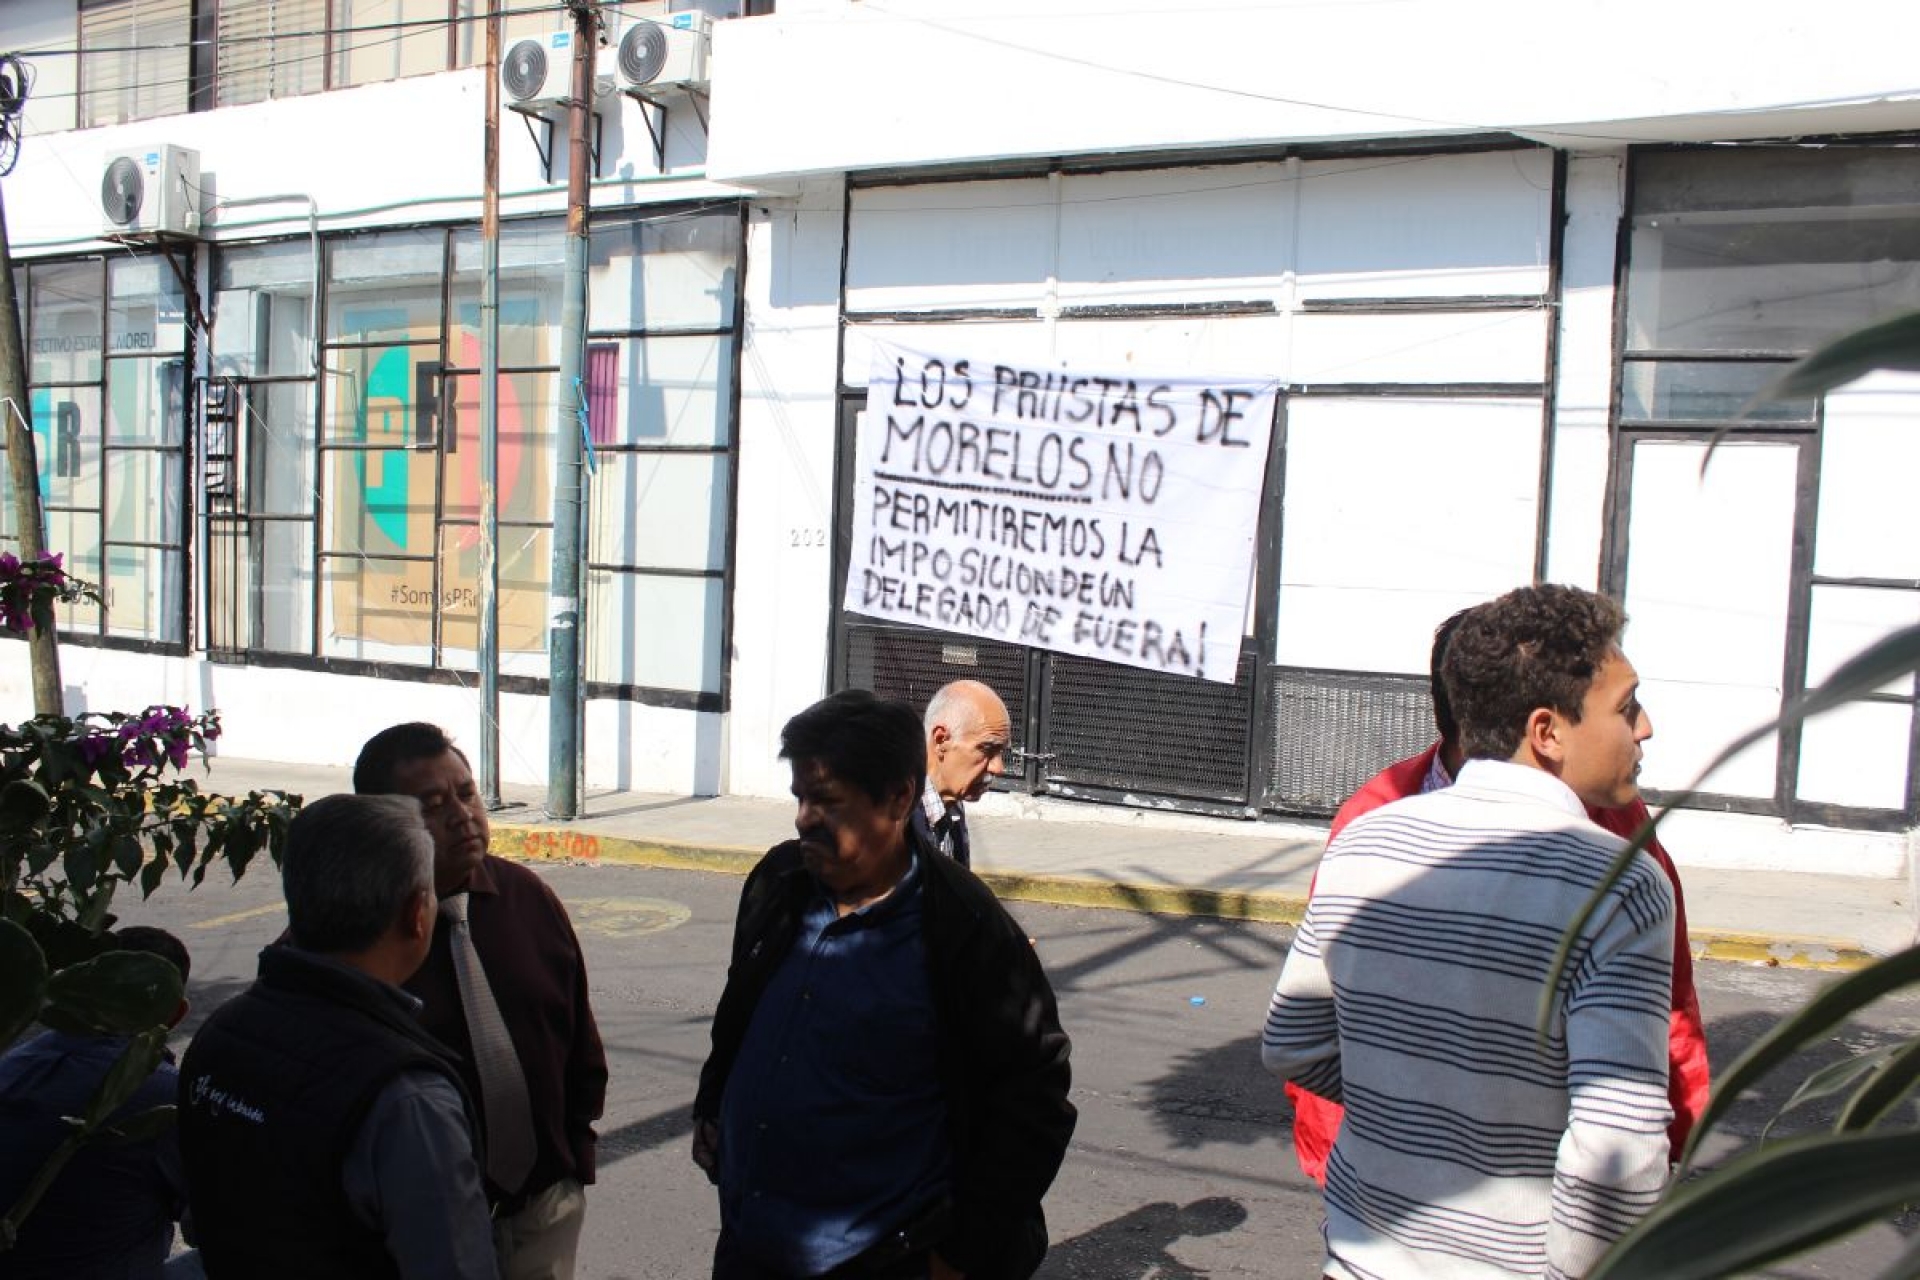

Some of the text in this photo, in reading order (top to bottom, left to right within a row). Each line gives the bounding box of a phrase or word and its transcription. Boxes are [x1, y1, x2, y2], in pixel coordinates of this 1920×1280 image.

[893, 357, 973, 409] LOS
[1196, 389, 1255, 448] DE
[880, 414, 1164, 504] MORELOS NO
[870, 534, 1134, 610] IMPOSICION DE UN
[872, 485, 1163, 569] PERMITIREMOS LA
[862, 568, 1207, 678] DELEGADO DE FUERA!
